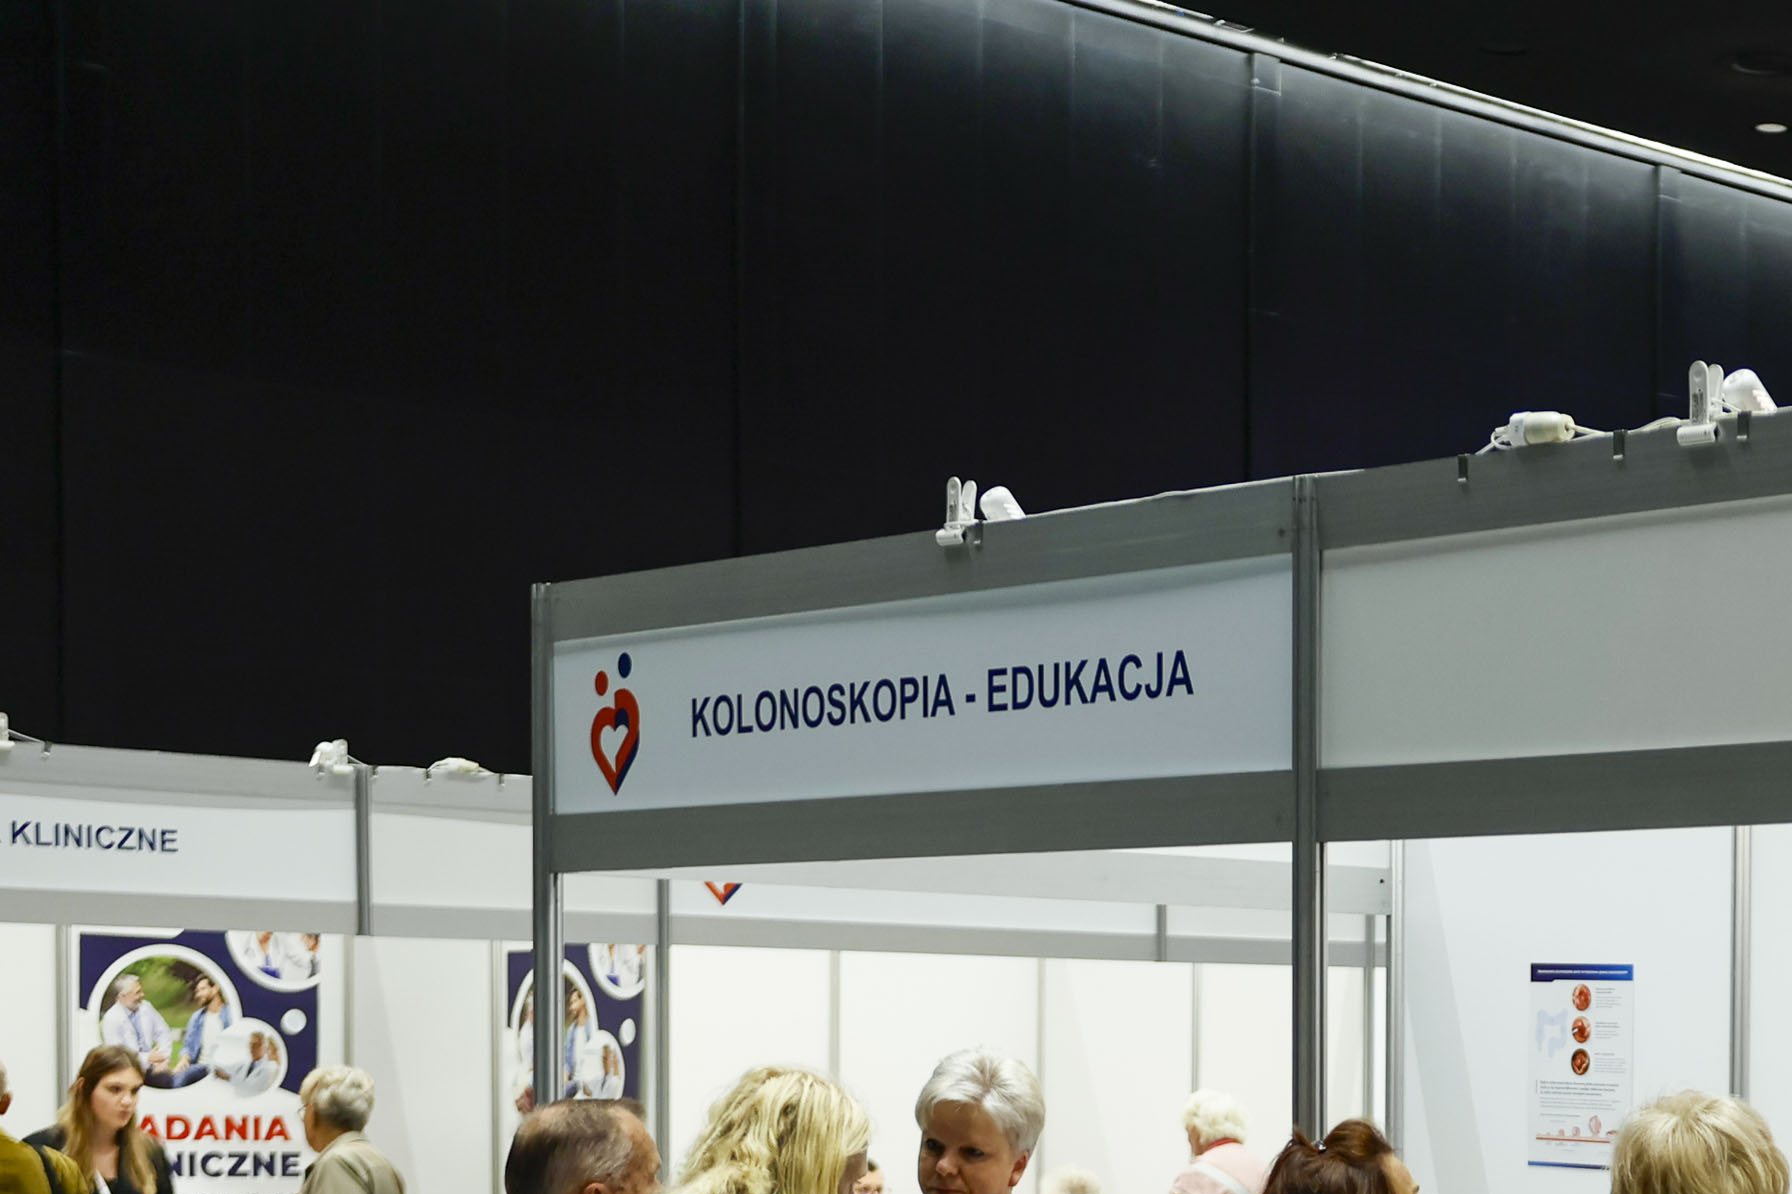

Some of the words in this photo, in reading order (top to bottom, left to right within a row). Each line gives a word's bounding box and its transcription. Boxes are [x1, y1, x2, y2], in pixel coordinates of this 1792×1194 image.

[691, 673, 956, 738] KOLONOSKOPIA
[965, 693, 977, 704] -
[987, 649, 1195, 713] EDUKACJA
[10, 820, 179, 853] KLINICZNE
[139, 1114, 292, 1142] ADANIA
